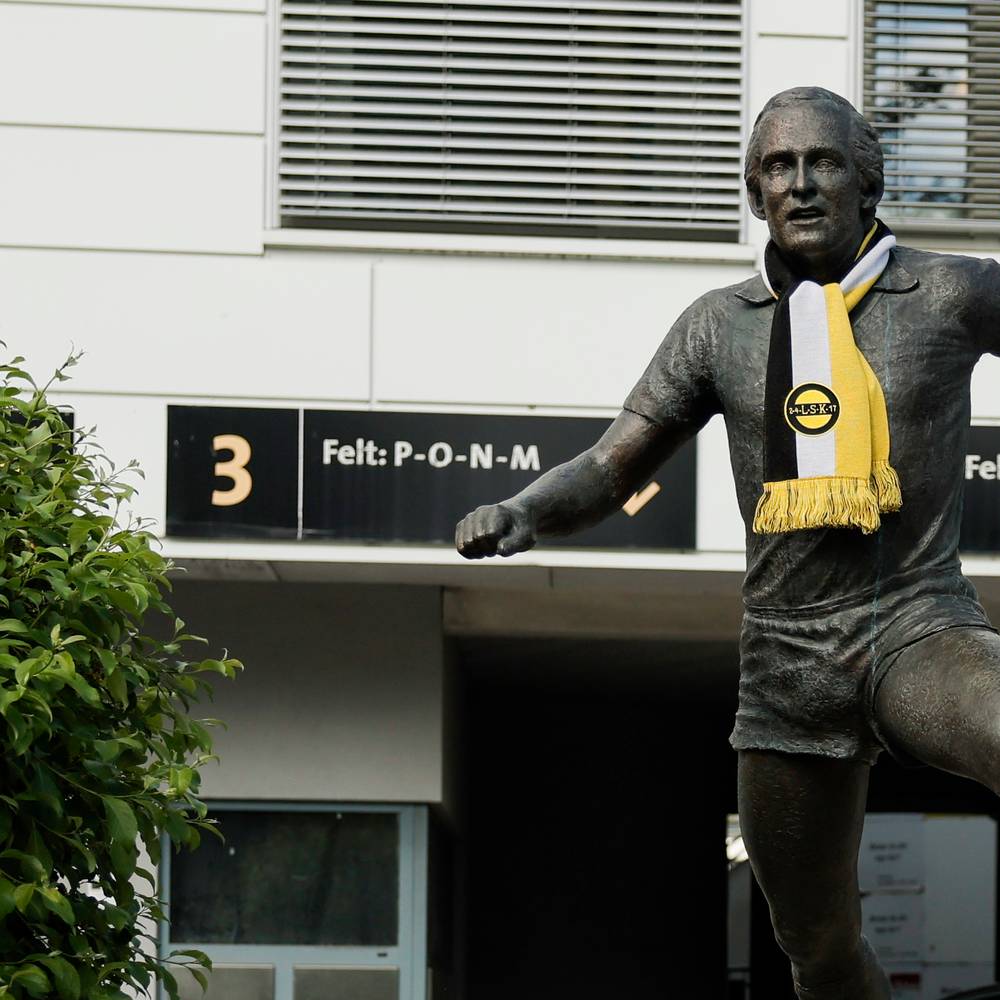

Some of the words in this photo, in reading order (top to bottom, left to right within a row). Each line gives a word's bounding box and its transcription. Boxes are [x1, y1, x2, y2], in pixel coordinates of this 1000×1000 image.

[211, 433, 254, 507] 3
[322, 438, 388, 466] Felt:
[393, 440, 542, 472] P-O-N-M
